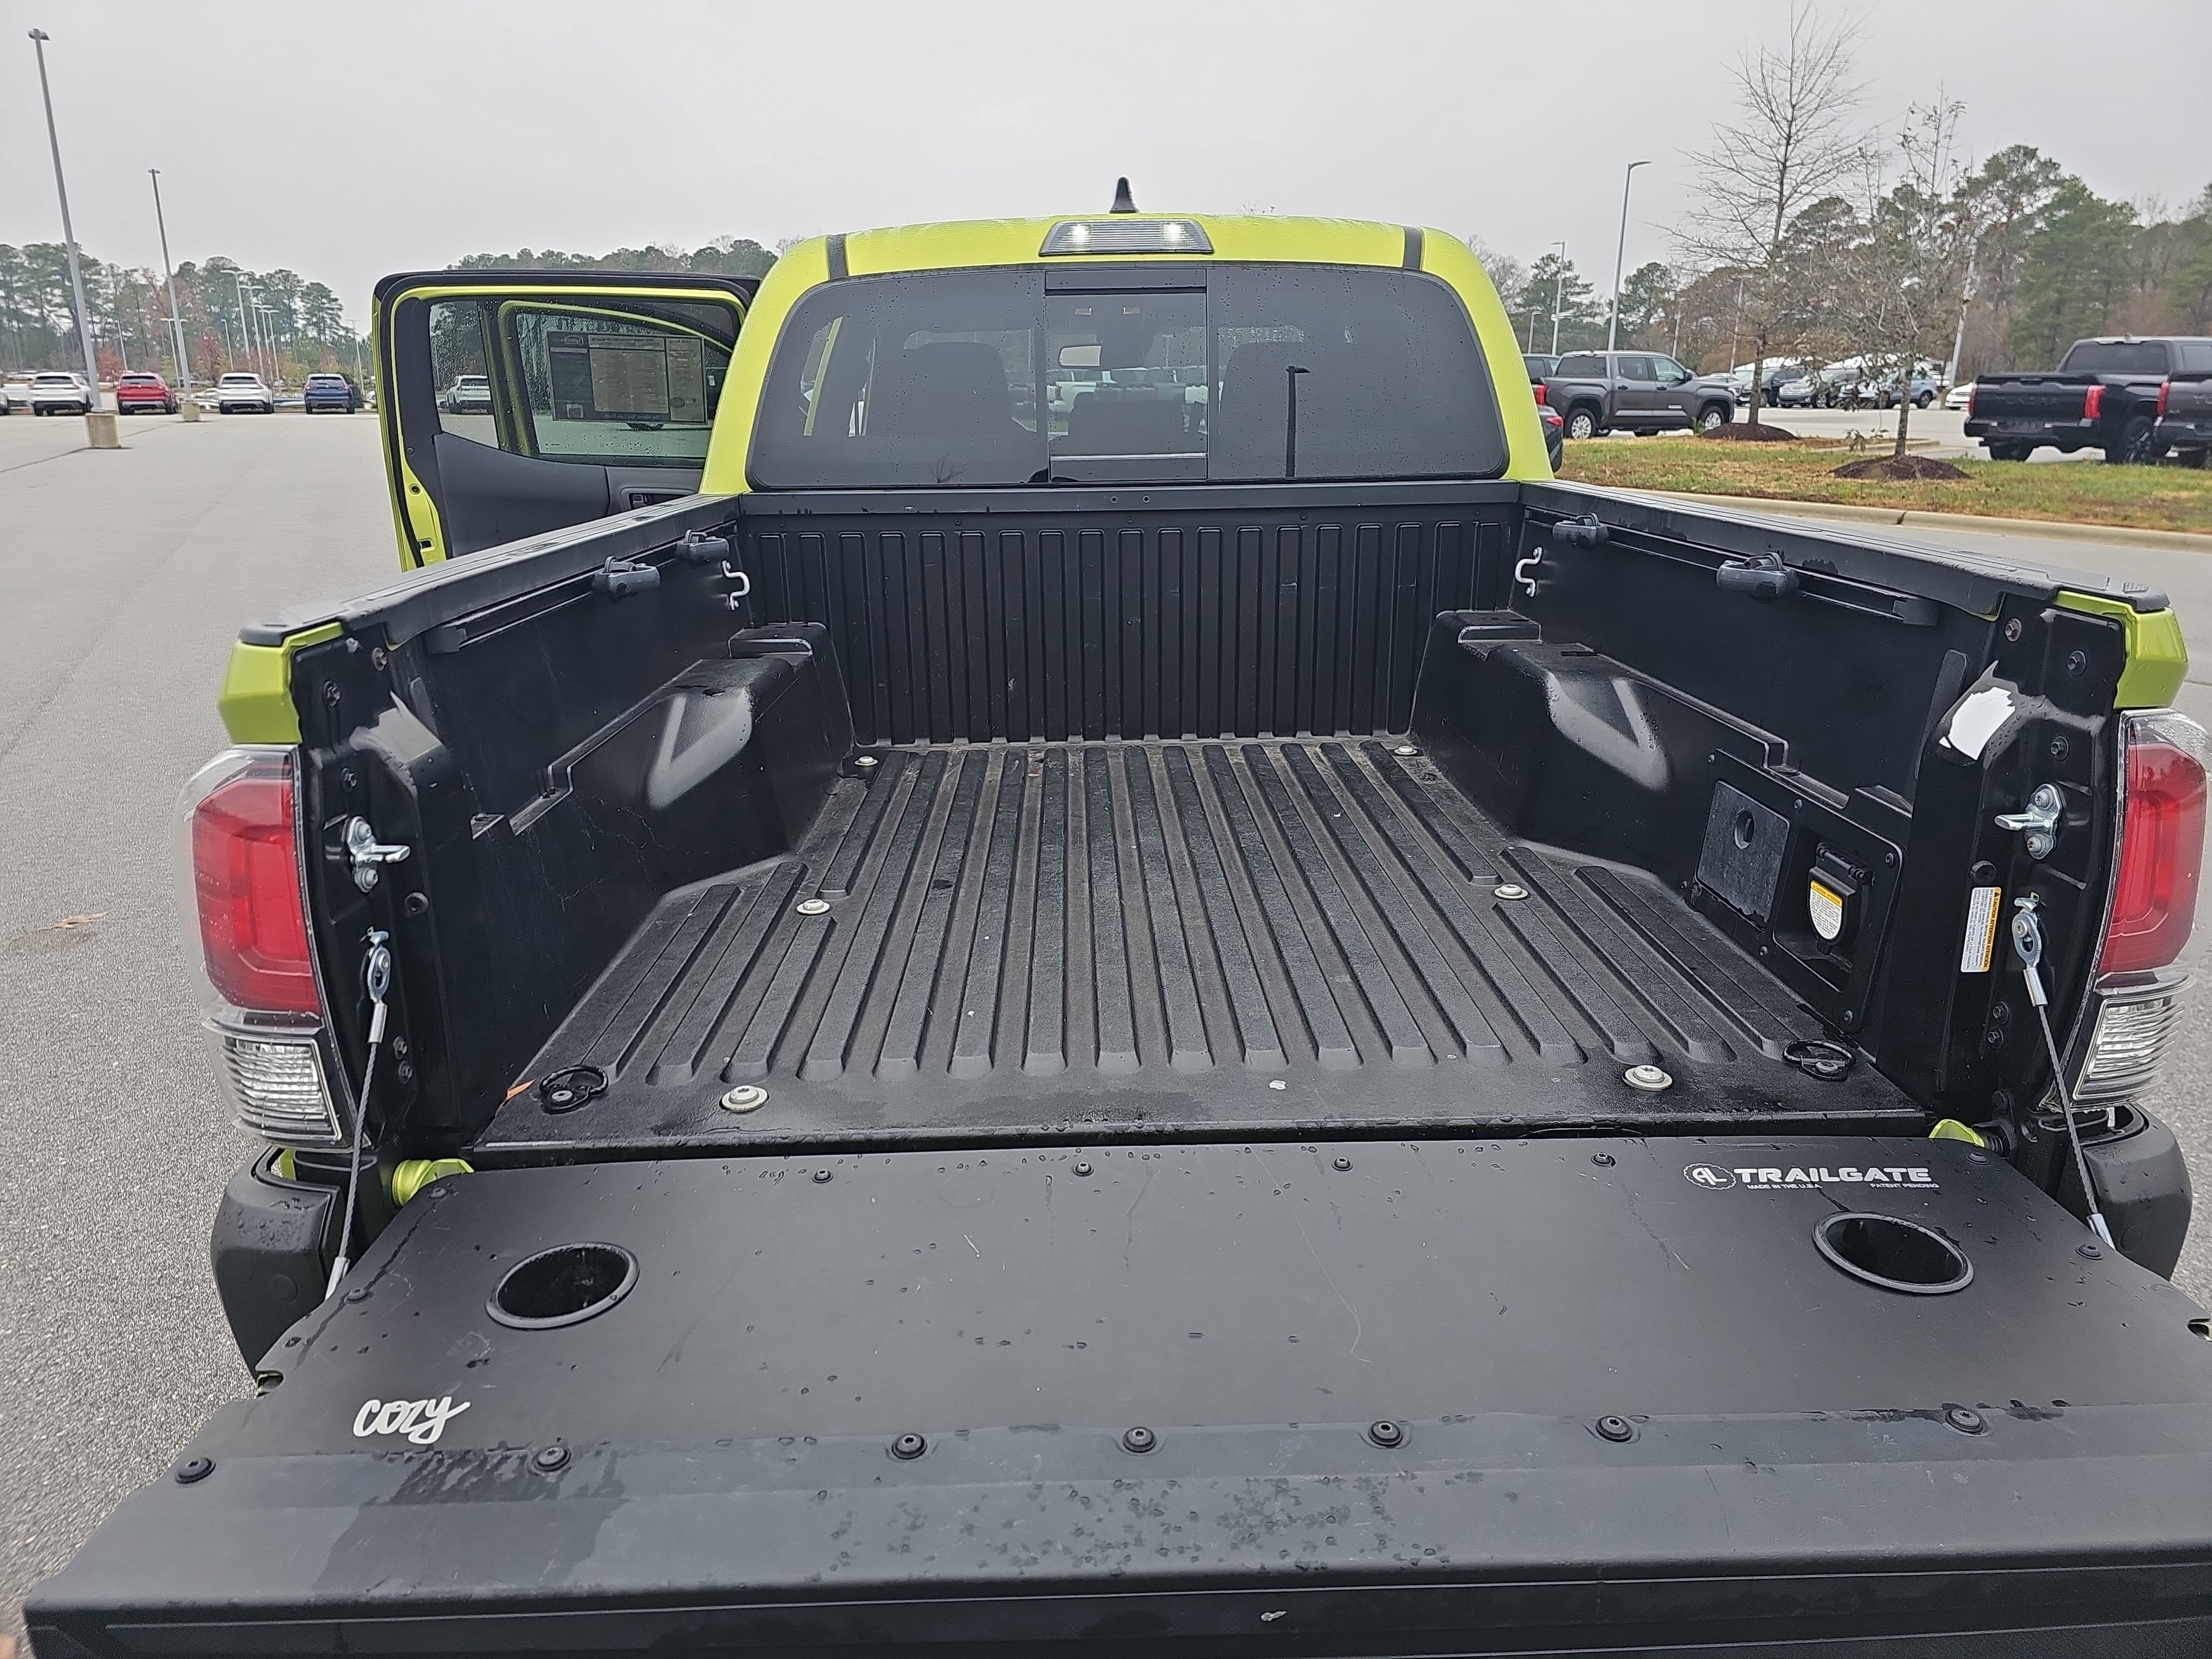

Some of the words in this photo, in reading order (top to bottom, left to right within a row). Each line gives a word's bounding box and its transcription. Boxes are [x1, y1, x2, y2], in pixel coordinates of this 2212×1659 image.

[1986, 919, 1995, 943] ATTENTION
[1734, 1167, 1932, 1183] TRAILGATE
[353, 1396, 471, 1444] cozy
